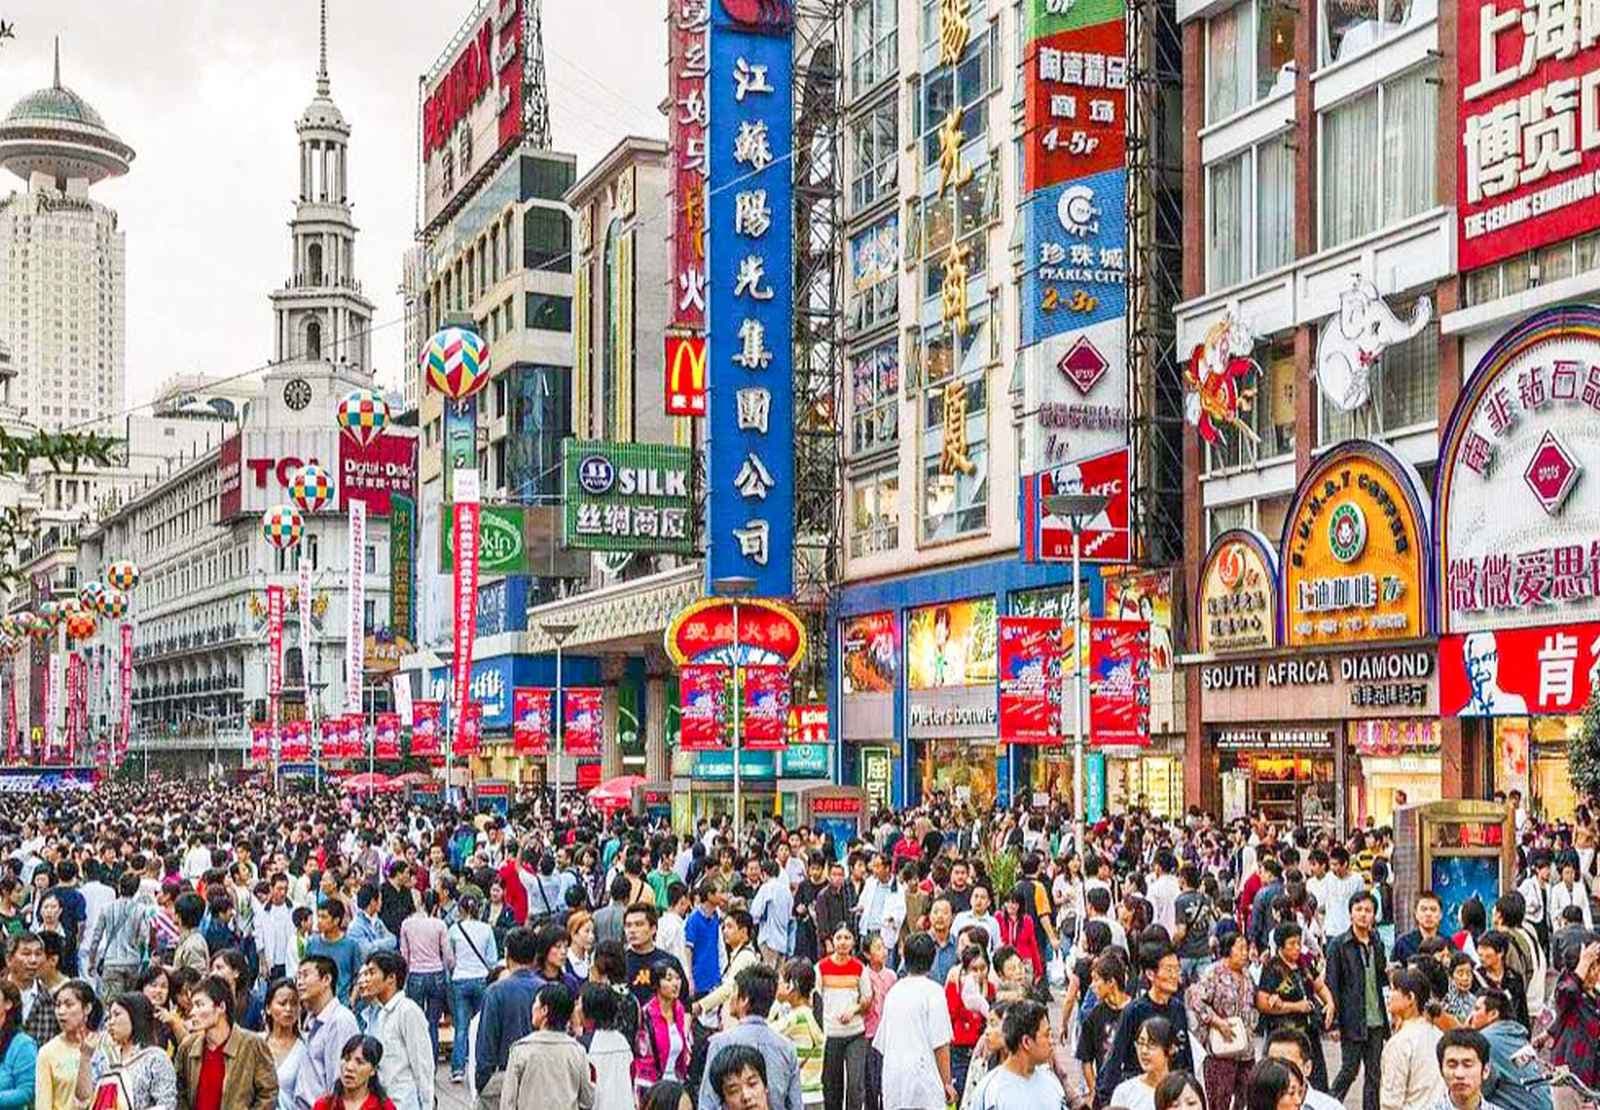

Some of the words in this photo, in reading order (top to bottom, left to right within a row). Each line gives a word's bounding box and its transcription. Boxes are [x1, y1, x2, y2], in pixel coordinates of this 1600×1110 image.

[733, 56, 775, 565] 江蘇陽光集團公司
[619, 467, 687, 496] SILK
[1202, 664, 1257, 690] SOUTH
[1266, 660, 1330, 685] AFRICA
[1341, 652, 1430, 680] DIAMOND
